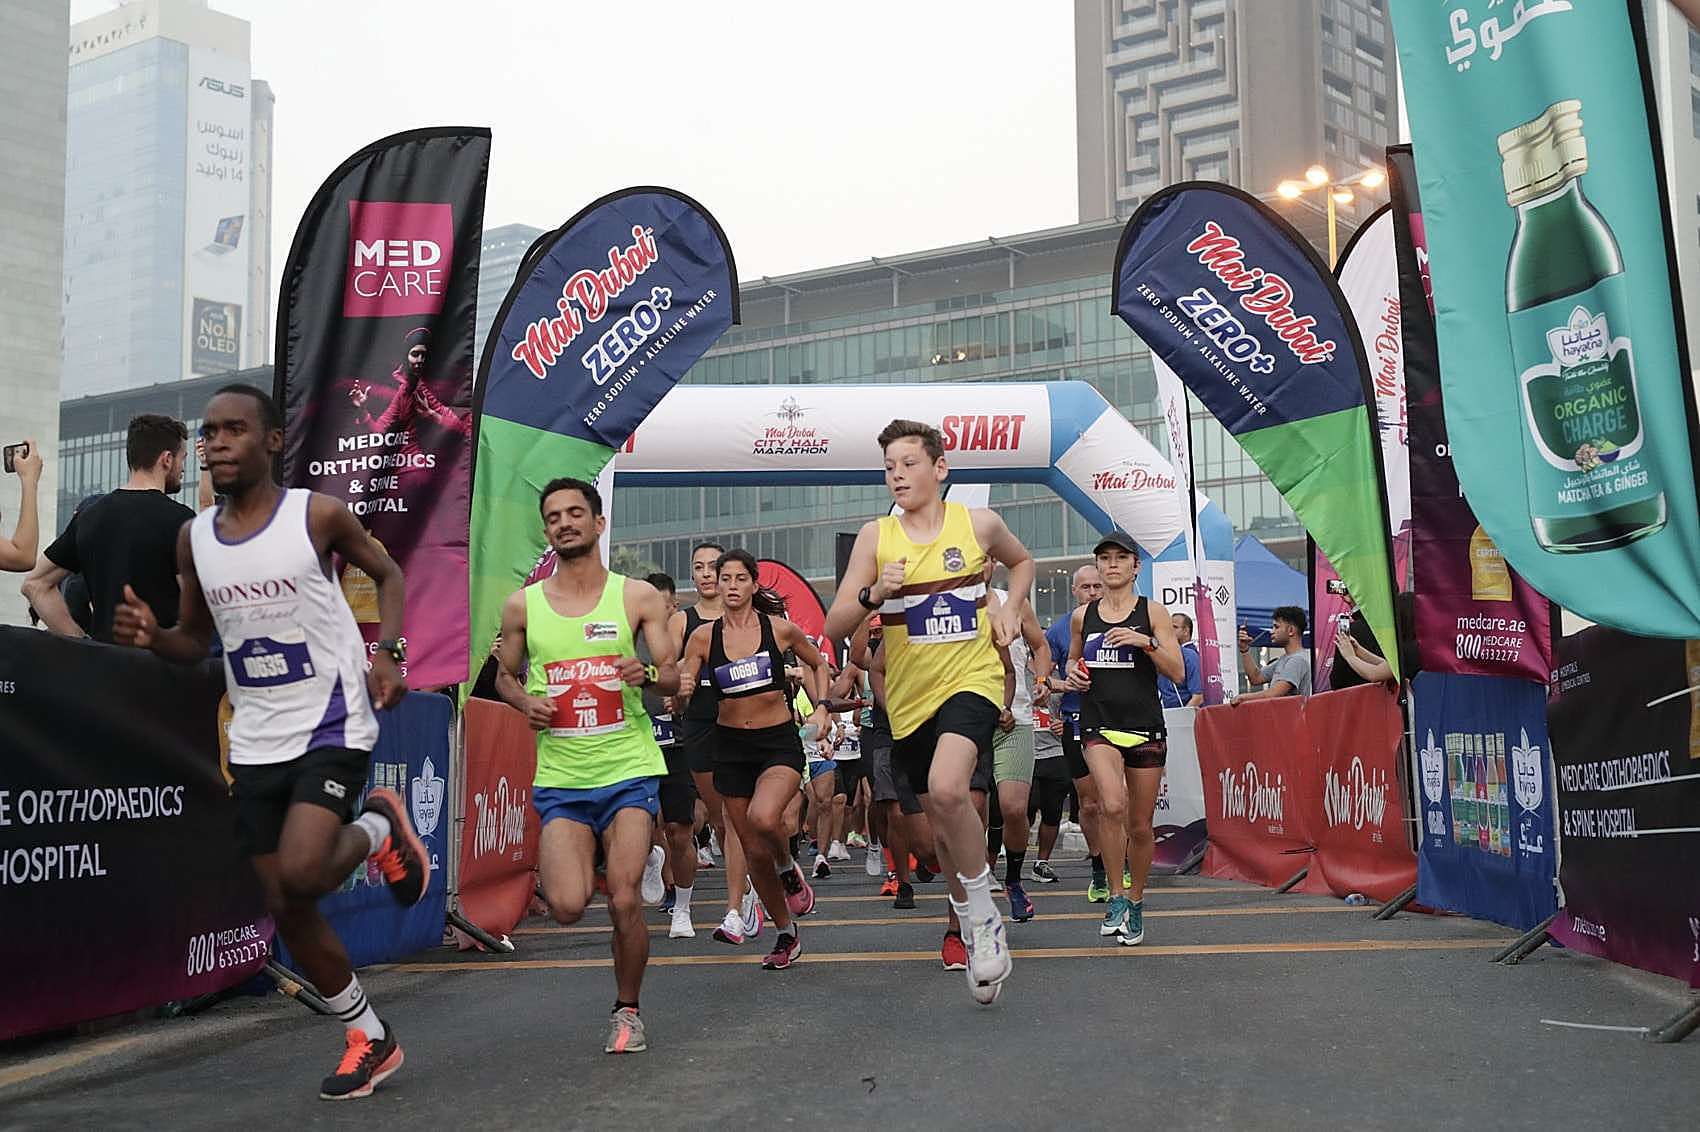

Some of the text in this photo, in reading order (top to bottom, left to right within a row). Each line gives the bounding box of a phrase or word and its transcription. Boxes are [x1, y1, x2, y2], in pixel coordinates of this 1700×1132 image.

[198, 77, 245, 98] ASUS
[354, 239, 441, 267] MED
[354, 270, 441, 297] CARE
[1187, 221, 1336, 364] Mai Dubai
[512, 225, 658, 379] Mai Dubai
[198, 335, 236, 353] OLED
[584, 401, 606, 426] ZERO
[604, 367, 639, 401] SODIUM
[645, 318, 689, 361] ALKALINE
[685, 289, 718, 322] WATER
[1137, 284, 1268, 416] ZERO SODIUM ALKALINE WATER
[1375, 296, 1401, 397] Mai Dubai
[1554, 386, 1627, 420] ORGANIC
[942, 415, 1025, 451] START
[1562, 406, 1627, 443] CHARGE
[753, 447, 828, 455] MARATHON
[754, 439, 830, 447] CITY HALF
[308, 453, 436, 476] ORTHOPEDICS
[349, 475, 399, 494] & SNE
[1092, 468, 1177, 491] Mai Dubai
[1605, 482, 1612, 494] &
[1614, 471, 1649, 492] GINGER
[347, 498, 408, 515] OSTAL
[925, 614, 962, 635] 10479
[1457, 612, 1527, 633] medcare.ae
[1097, 649, 1118, 662] 10441
[1456, 633, 1524, 660] 800 MEDCARE
[1480, 648, 1520, 662] 6332273
[548, 664, 577, 684] Mai
[575, 708, 598, 728] 718
[1560, 762, 1601, 792] MEDCARE
[1600, 750, 1671, 790] ORTHOPAEDICS
[18, 785, 185, 826] ORTHOPAEDICS
[1219, 761, 1283, 823] Mai Dubai
[1324, 756, 1387, 830] Mai Dubai
[475, 776, 526, 861] Mai Dubai
[1564, 809, 1571, 837] &
[1571, 809, 1597, 838] SPINE
[1596, 808, 1638, 839] HOSPITAL
[188, 924, 260, 976] 800 MEDCARE
[219, 940, 268, 968] 6332273
